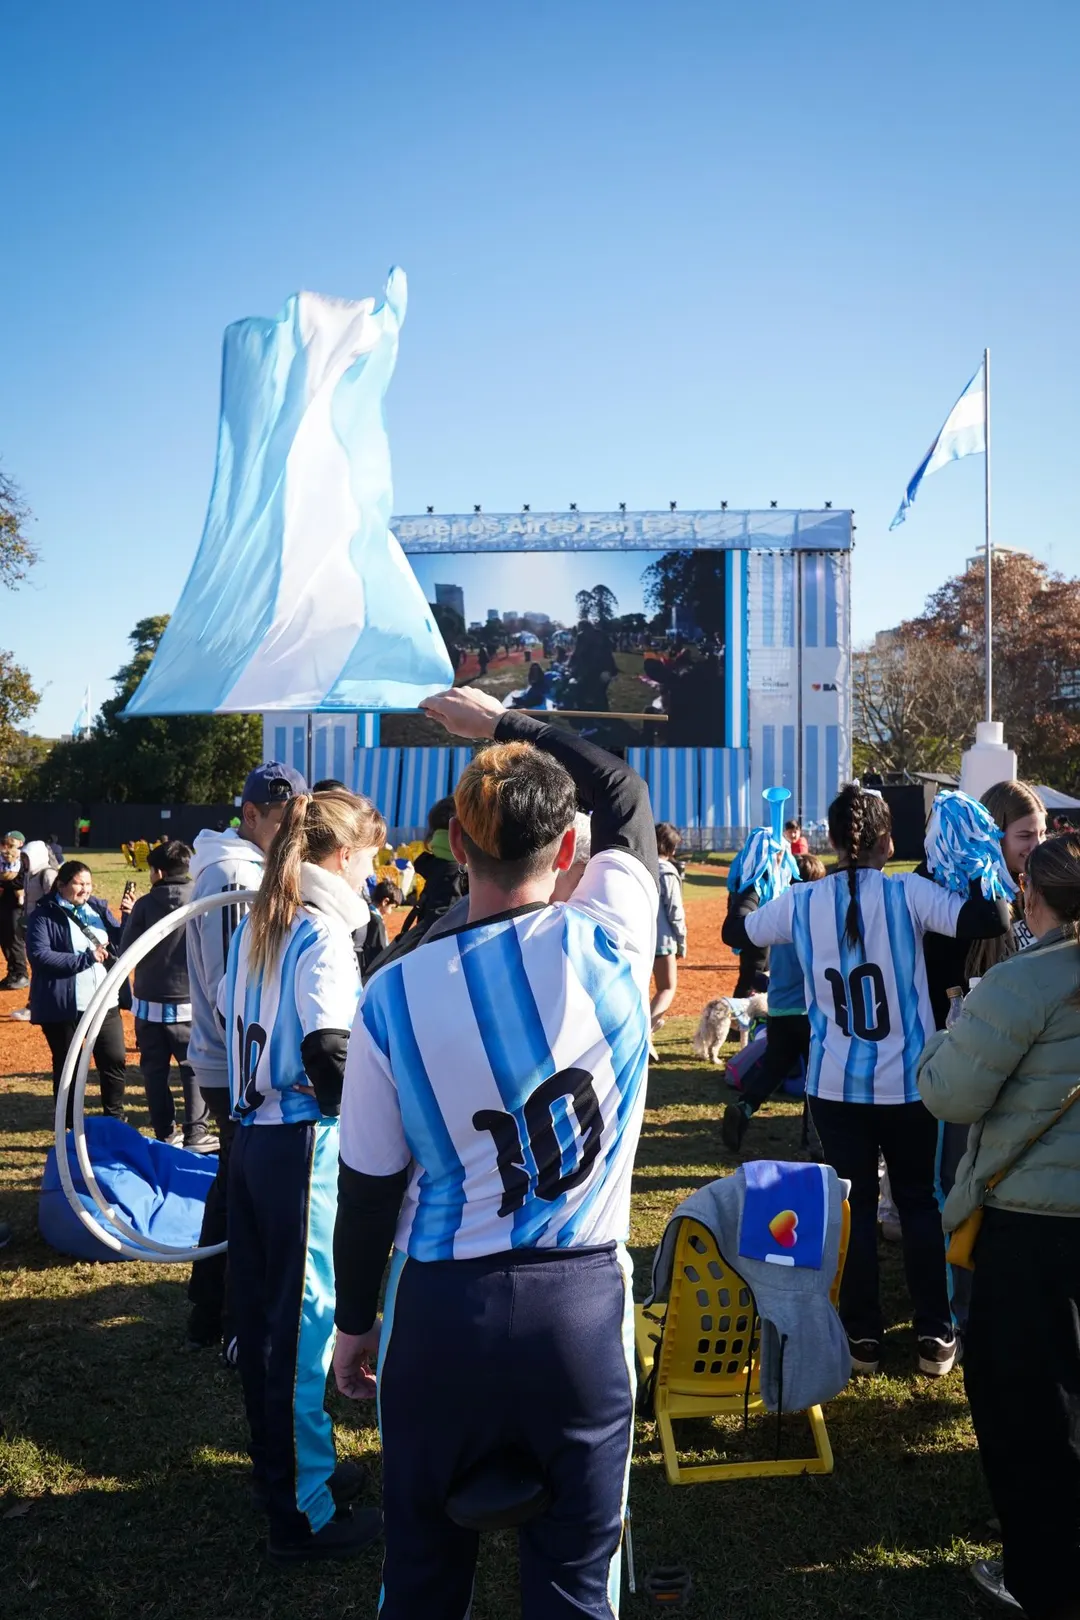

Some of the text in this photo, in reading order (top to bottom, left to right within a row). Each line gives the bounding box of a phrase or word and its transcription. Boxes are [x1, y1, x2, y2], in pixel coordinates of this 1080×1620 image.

[399, 519, 499, 537] Buenos
[507, 516, 577, 534] Aires
[823, 683, 837, 692] BA
[824, 962, 891, 1042] 10
[234, 1015, 267, 1118] 10
[472, 1067, 605, 1218] 10
